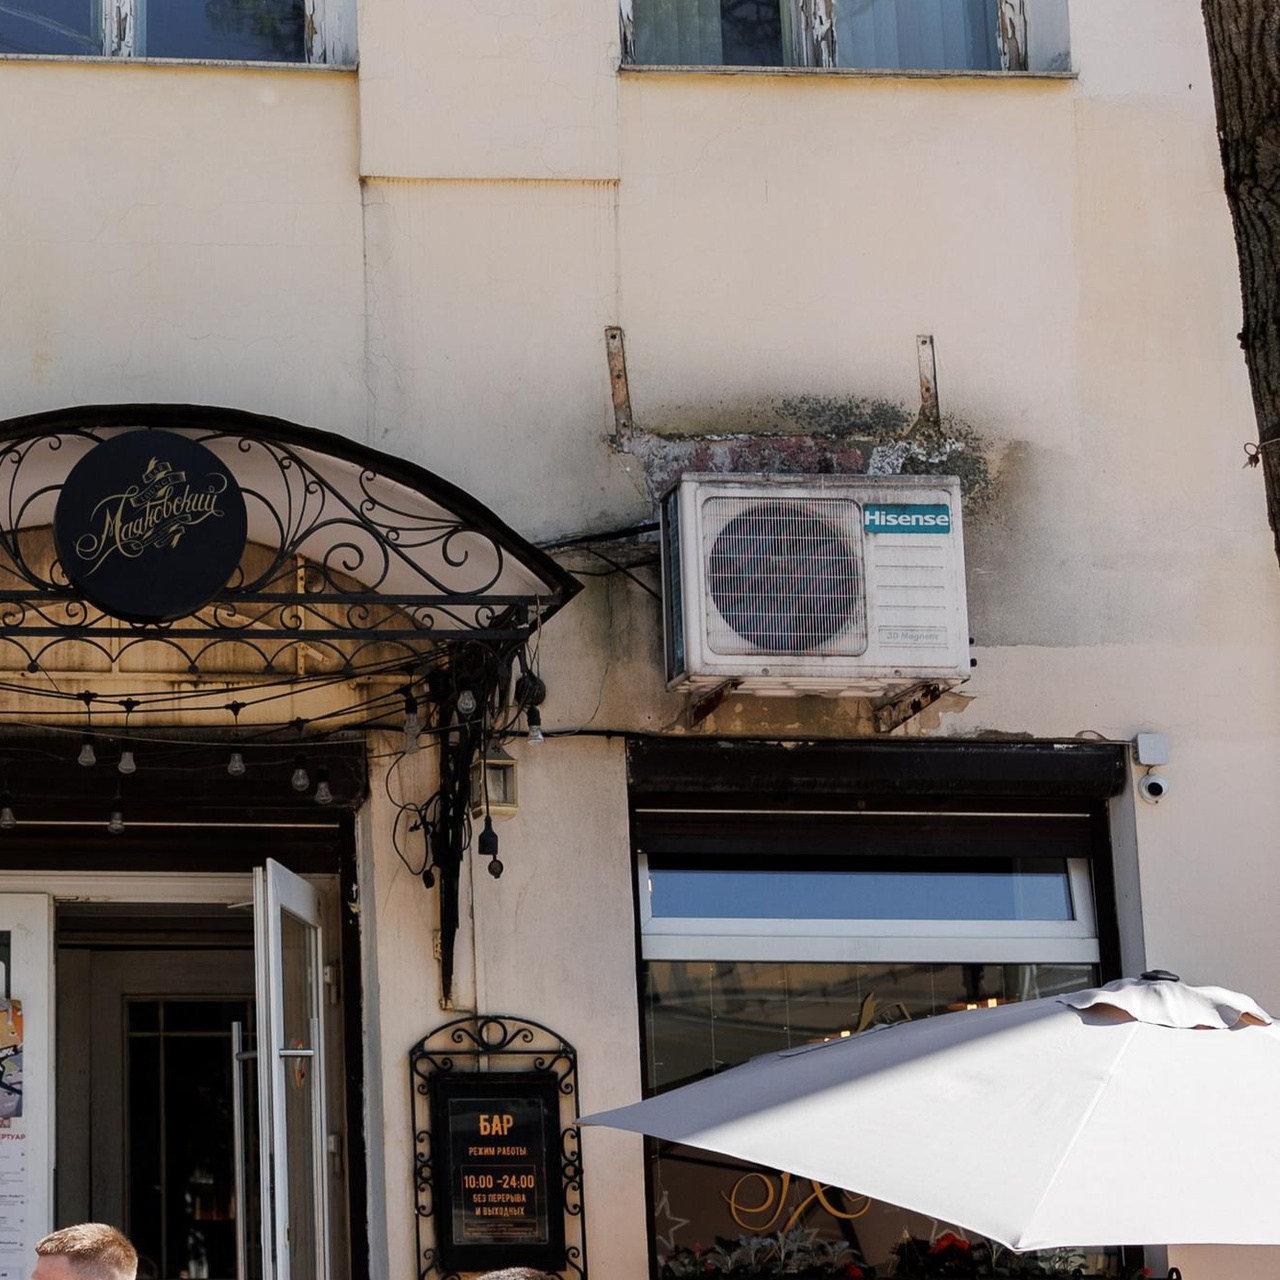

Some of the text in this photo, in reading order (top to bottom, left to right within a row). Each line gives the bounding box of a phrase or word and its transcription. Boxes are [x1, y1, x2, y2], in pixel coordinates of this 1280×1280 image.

[76, 477, 226, 568] Маяковский
[864, 510, 949, 526] Hisense
[900, 631, 940, 641] Magnetic
[479, 1114, 514, 1136] БАР
[468, 1146, 527, 1156] РЕЖИМ РАБОТЫ
[464, 1174, 493, 1189] 10:00
[472, 1193, 526, 1203] БЕЗ ПЕРЕРЫВА
[475, 1206, 525, 1217] И ВЫХОДНЫХ
